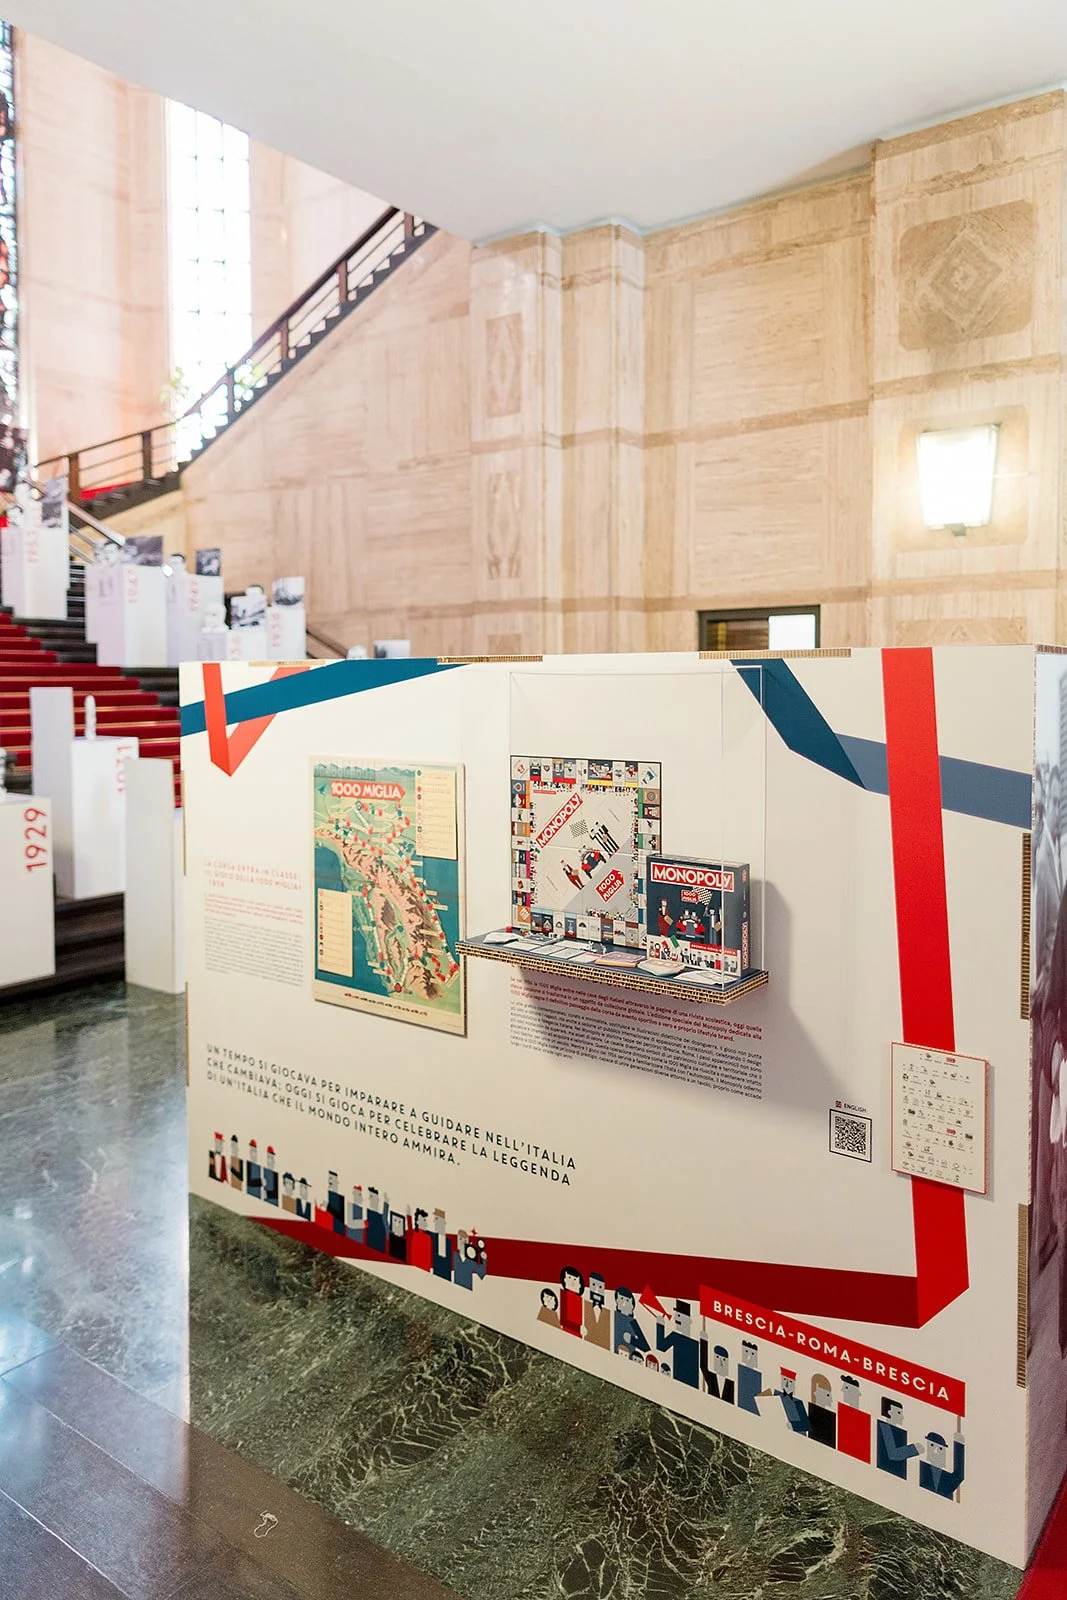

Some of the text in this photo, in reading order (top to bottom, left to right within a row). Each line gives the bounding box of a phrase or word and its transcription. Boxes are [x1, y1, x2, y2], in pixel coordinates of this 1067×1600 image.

[332, 781, 402, 799] 1000 MIGLIA
[537, 793, 583, 848] MONOPOLY
[24, 808, 47, 872] 1929
[598, 873, 615, 892] 1000
[653, 866, 732, 889] MONOPOLY
[603, 880, 622, 901] MIGLIA
[677, 1024, 696, 1034] proprio
[688, 1012, 703, 1020] rivista
[705, 1016, 732, 1026] scolastica,
[733, 1021, 744, 1029] oggi
[746, 1024, 761, 1032] quella
[702, 1023, 726, 1033] Monopoly
[728, 1028, 751, 1037] dedicata
[207, 1044, 219, 1054] UN
[223, 1048, 255, 1066] TEMPO
[259, 1060, 268, 1070] SI
[271, 1064, 317, 1086] GIOCAVA
[321, 1079, 341, 1094] PER
[345, 1087, 405, 1115] IMPARARE
[410, 1108, 417, 1118] A
[422, 1111, 480, 1139] GUIDARE
[207, 1071, 217, 1082] DI
[272, 1093, 291, 1108] CHE
[295, 1102, 305, 1112] IL
[308, 1105, 351, 1127] MONDO
[354, 1121, 399, 1144] INTERO
[403, 1138, 460, 1166] AMMIRA.
[844, 1103, 867, 1113] ENGLISH
[207, 1057, 224, 1071] CHE
[285, 1083, 312, 1099] OGGI
[316, 1093, 325, 1104] SI
[329, 1098, 365, 1117] GIOCA
[369, 1110, 390, 1125] PER
[395, 1118, 466, 1151] CELEBRARE
[472, 1143, 488, 1158] LA
[494, 1151, 570, 1186] LEGGENDA
[713, 1300, 950, 1402] BRESCIA-ROMA-BRESCIA
